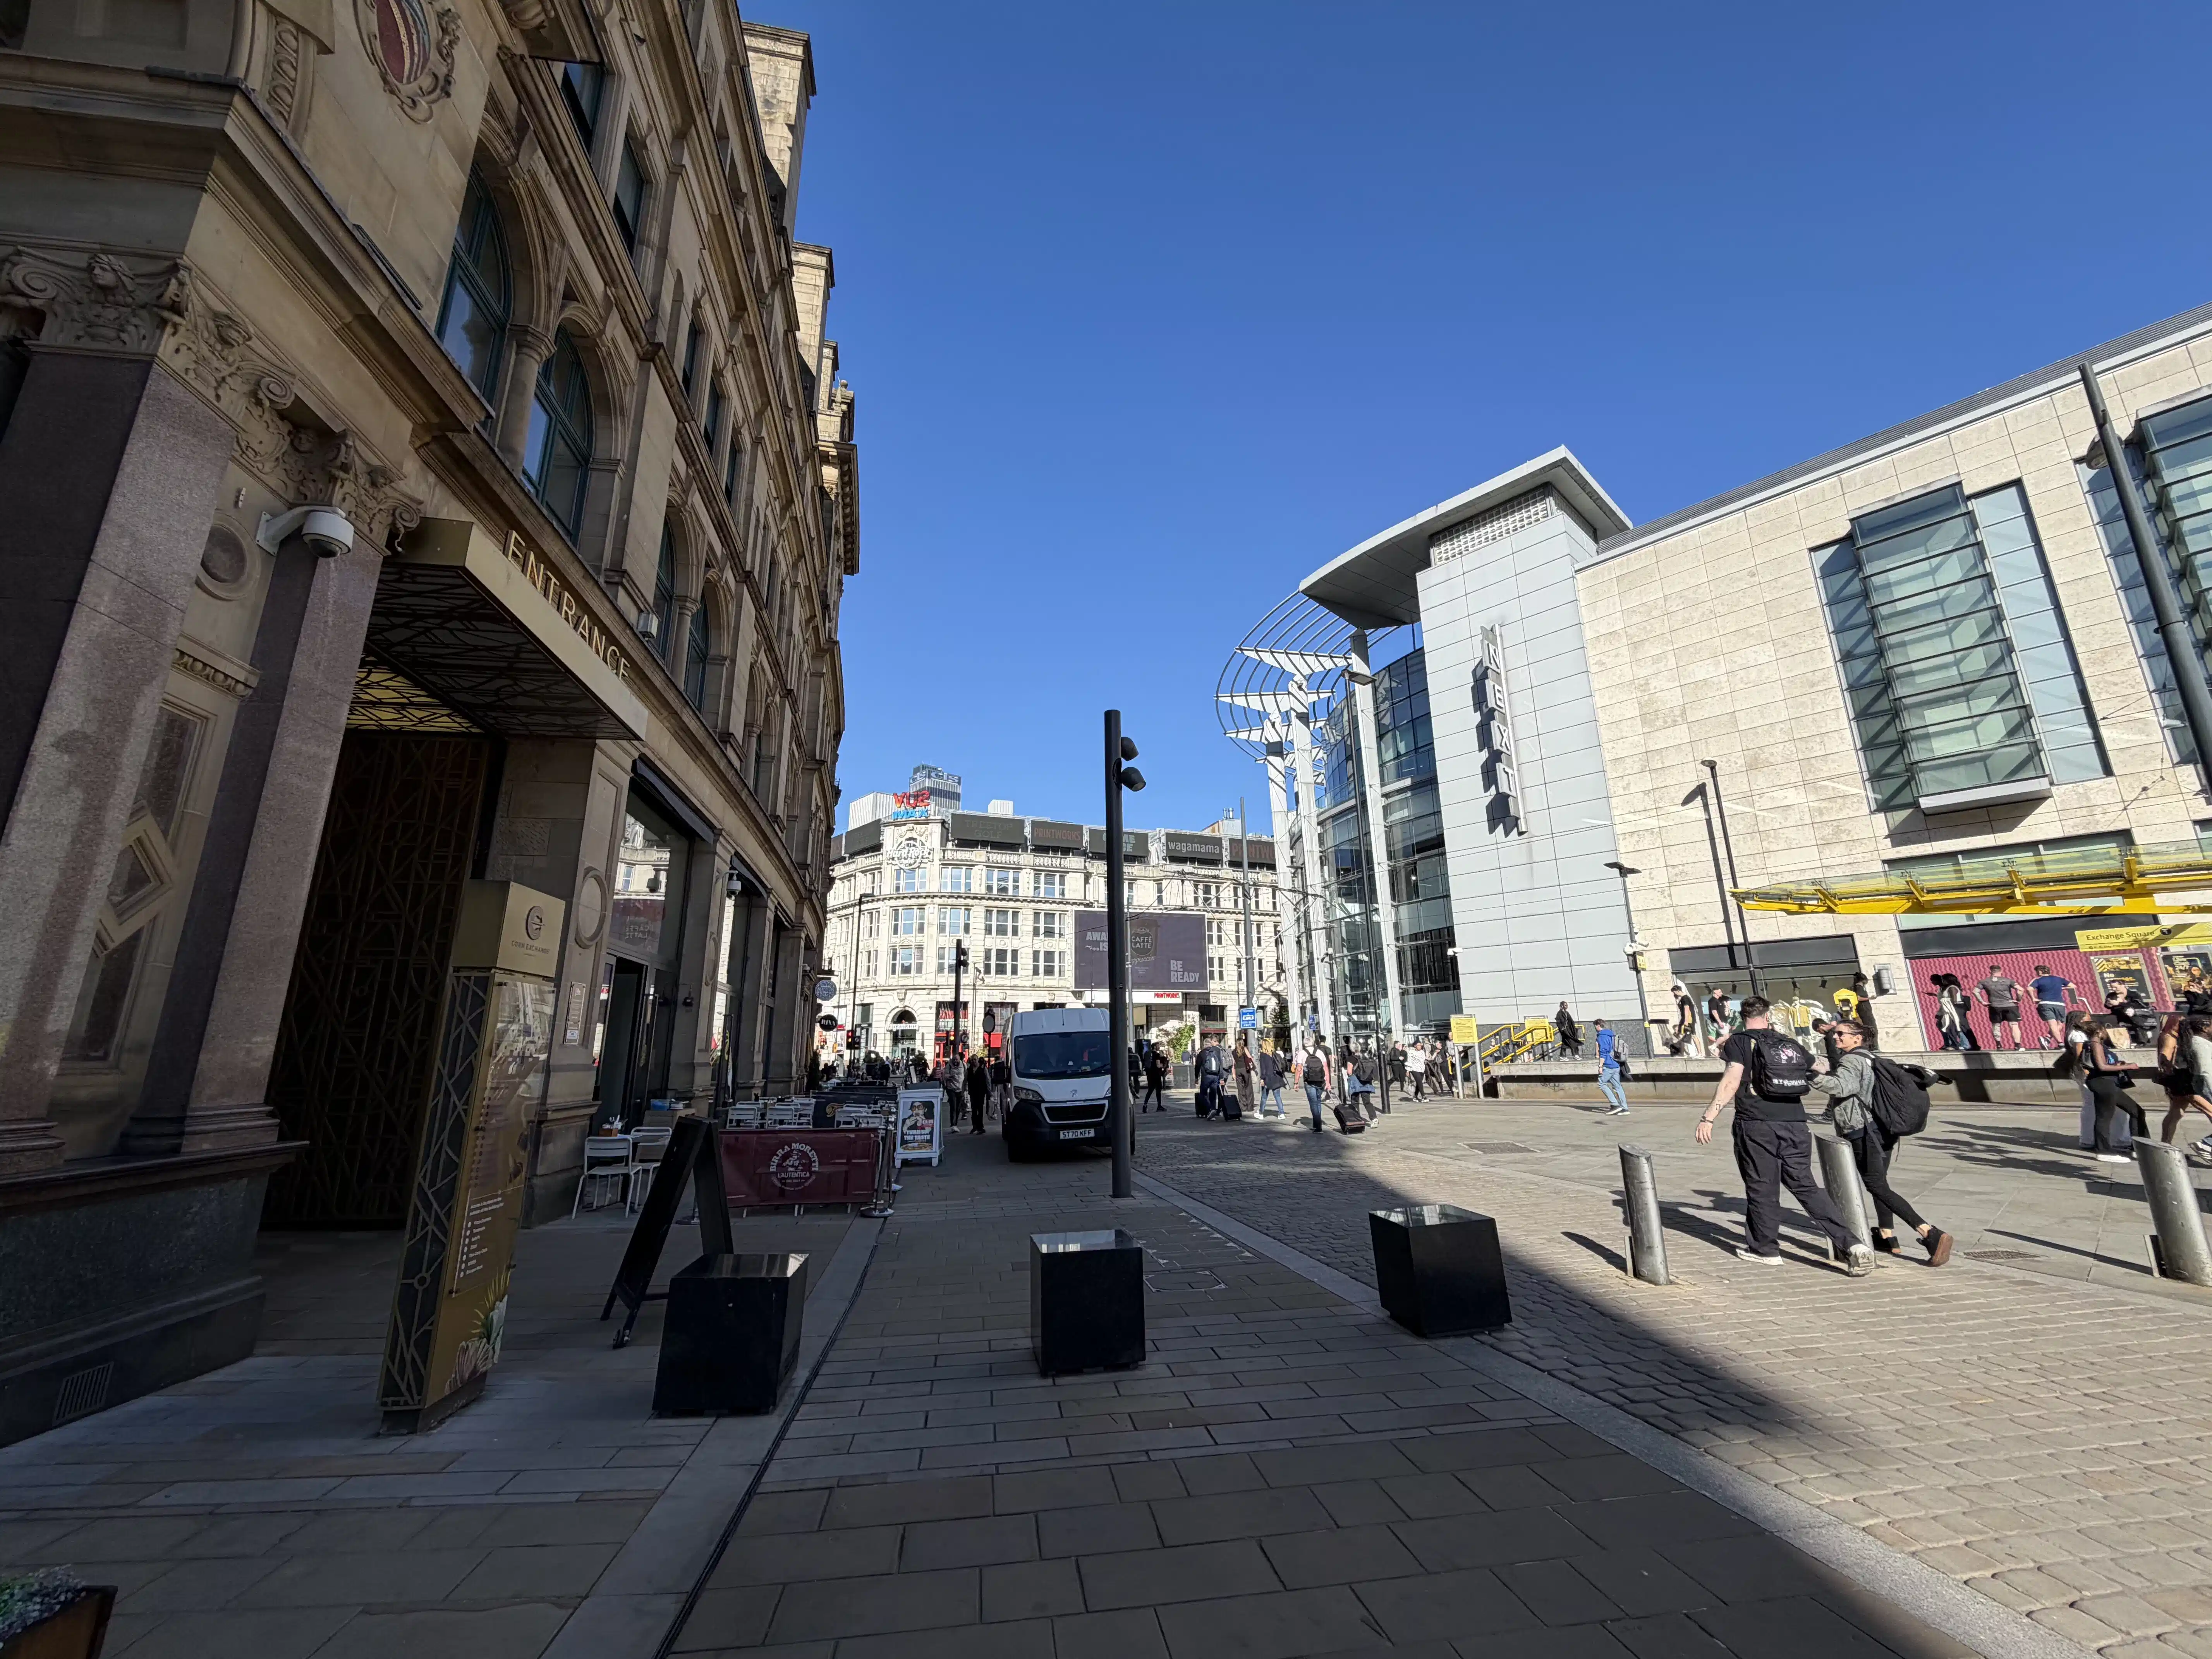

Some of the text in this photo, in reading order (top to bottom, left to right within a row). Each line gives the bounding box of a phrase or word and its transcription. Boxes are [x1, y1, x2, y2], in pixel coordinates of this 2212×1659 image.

[506, 530, 630, 681] ENTRANCE
[1487, 641, 1515, 794] NEXT
[931, 771, 959, 783] CIS
[893, 807, 929, 820] IMAX
[965, 820, 1013, 831] TREETOP
[974, 830, 1003, 839] GOLF
[1034, 827, 1080, 841] PRINTWORKS
[886, 847, 931, 860] Hard Rock
[1168, 841, 1219, 854] wagamama
[2086, 931, 2155, 941] Exchange Square
[511, 940, 526, 948] CORN
[526, 943, 550, 955] EXCHANGE
[1170, 959, 1183, 972] BE
[1170, 971, 1200, 983] READY
[769, 1143, 819, 1171] BIRRA MORETTI
